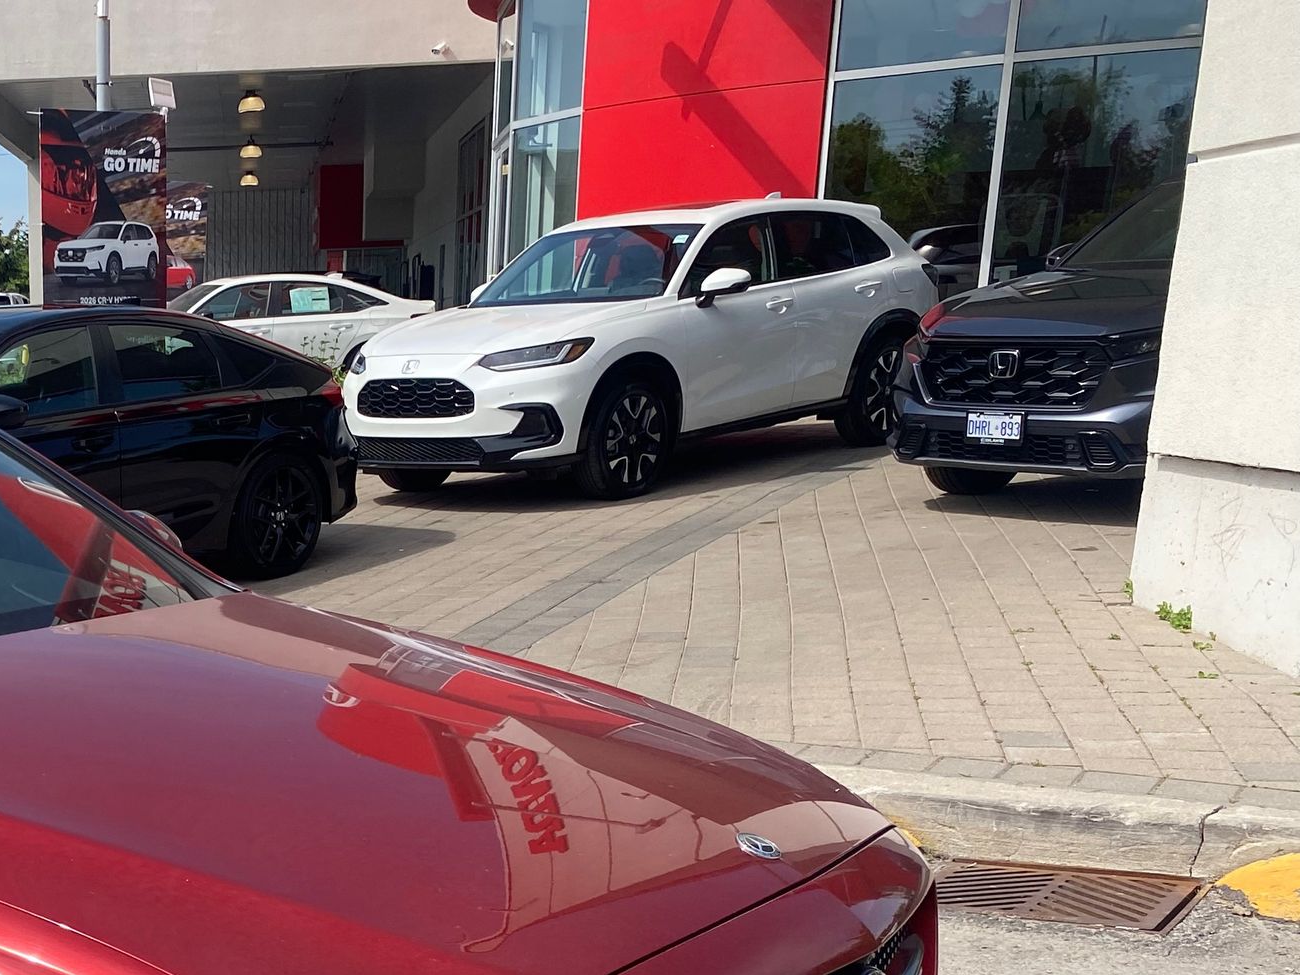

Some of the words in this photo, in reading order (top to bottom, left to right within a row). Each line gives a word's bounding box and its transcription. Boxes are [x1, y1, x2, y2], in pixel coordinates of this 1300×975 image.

[104, 148, 126, 156] Honda
[103, 157, 126, 172] GO
[127, 157, 160, 173] TIME
[173, 210, 201, 220] TIME
[80, 296, 97, 305] 2026
[97, 296, 114, 304] CR-V
[968, 420, 993, 436] DHRL
[1000, 421, 1021, 437] 893
